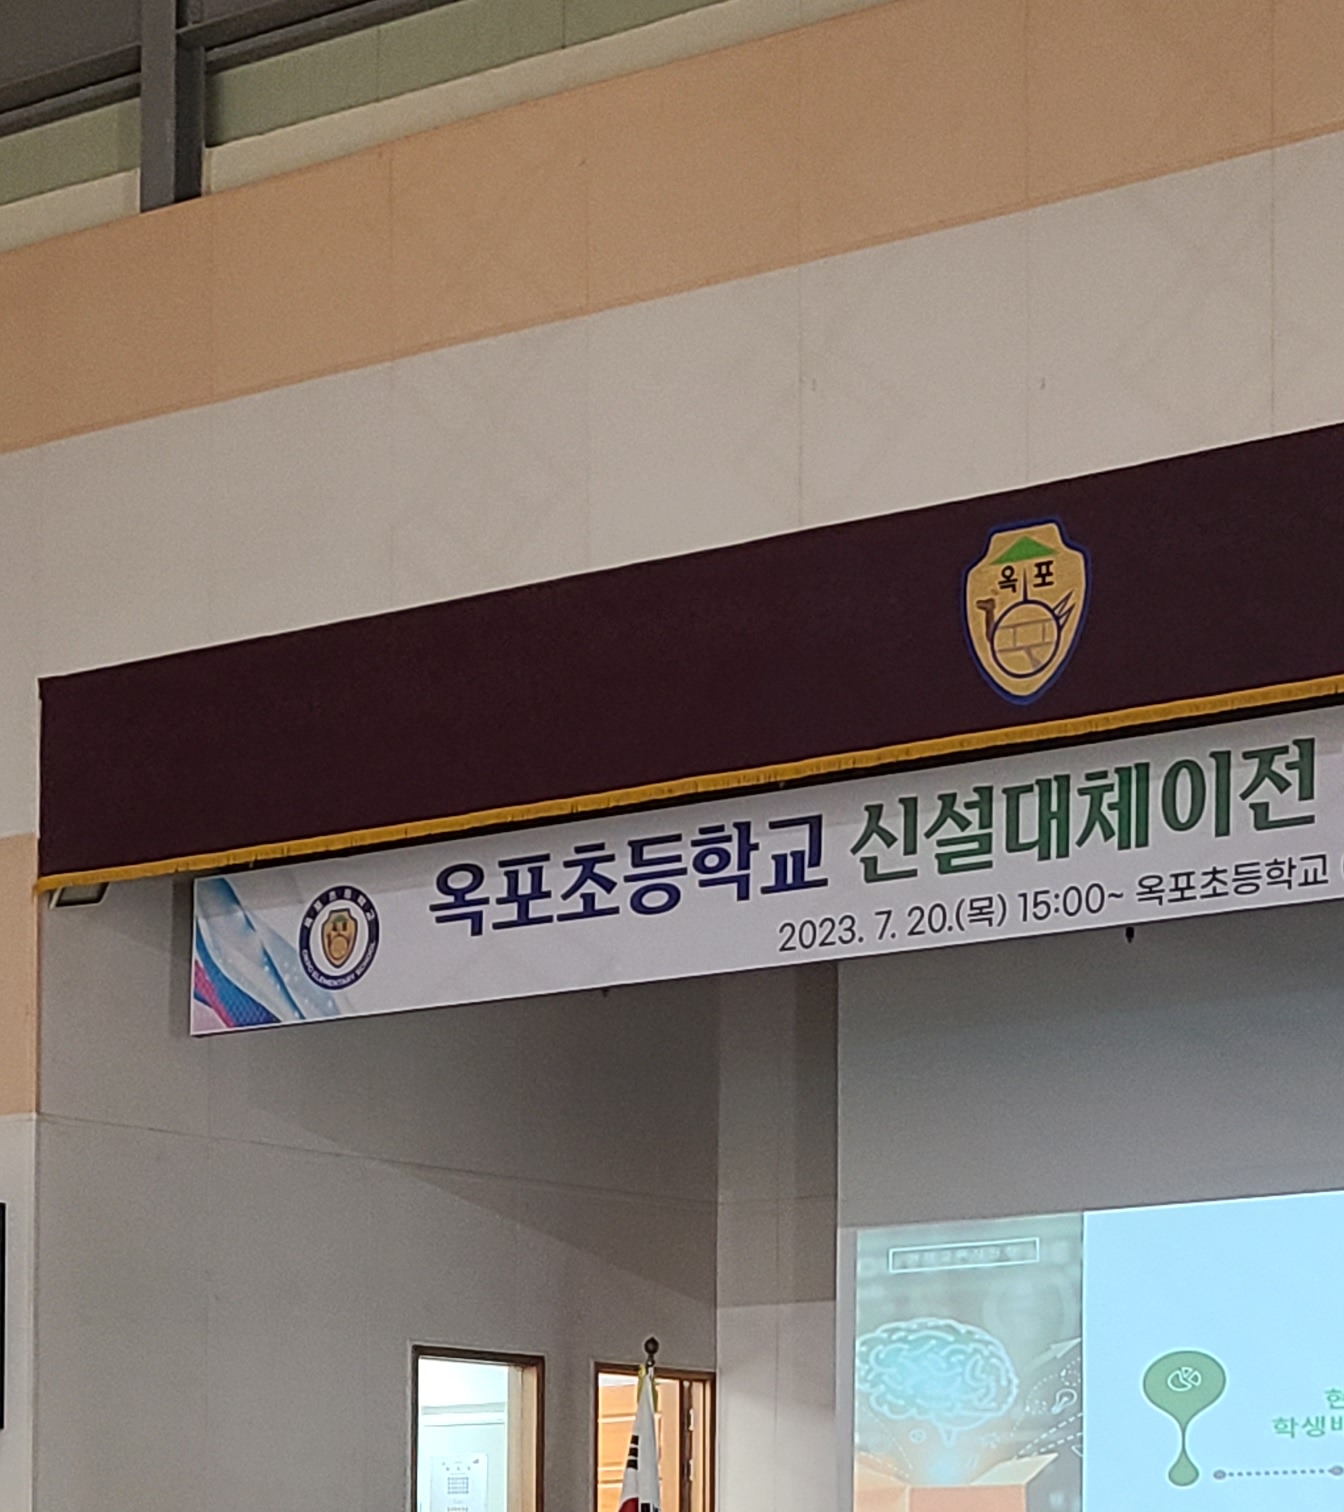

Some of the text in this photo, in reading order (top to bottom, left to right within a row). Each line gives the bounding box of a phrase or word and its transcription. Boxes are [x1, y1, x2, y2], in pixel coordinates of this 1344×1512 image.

[997, 560, 1055, 593] 옥포
[429, 814, 829, 936] 옥포초등학교
[850, 738, 1316, 884] 신설대체이전
[778, 914, 865, 952] 2023.
[875, 909, 897, 941] 7.
[907, 894, 1007, 937] 20.(목)
[1018, 882, 1124, 921] 15:00~
[1135, 853, 1328, 906] 옥포초등학교
